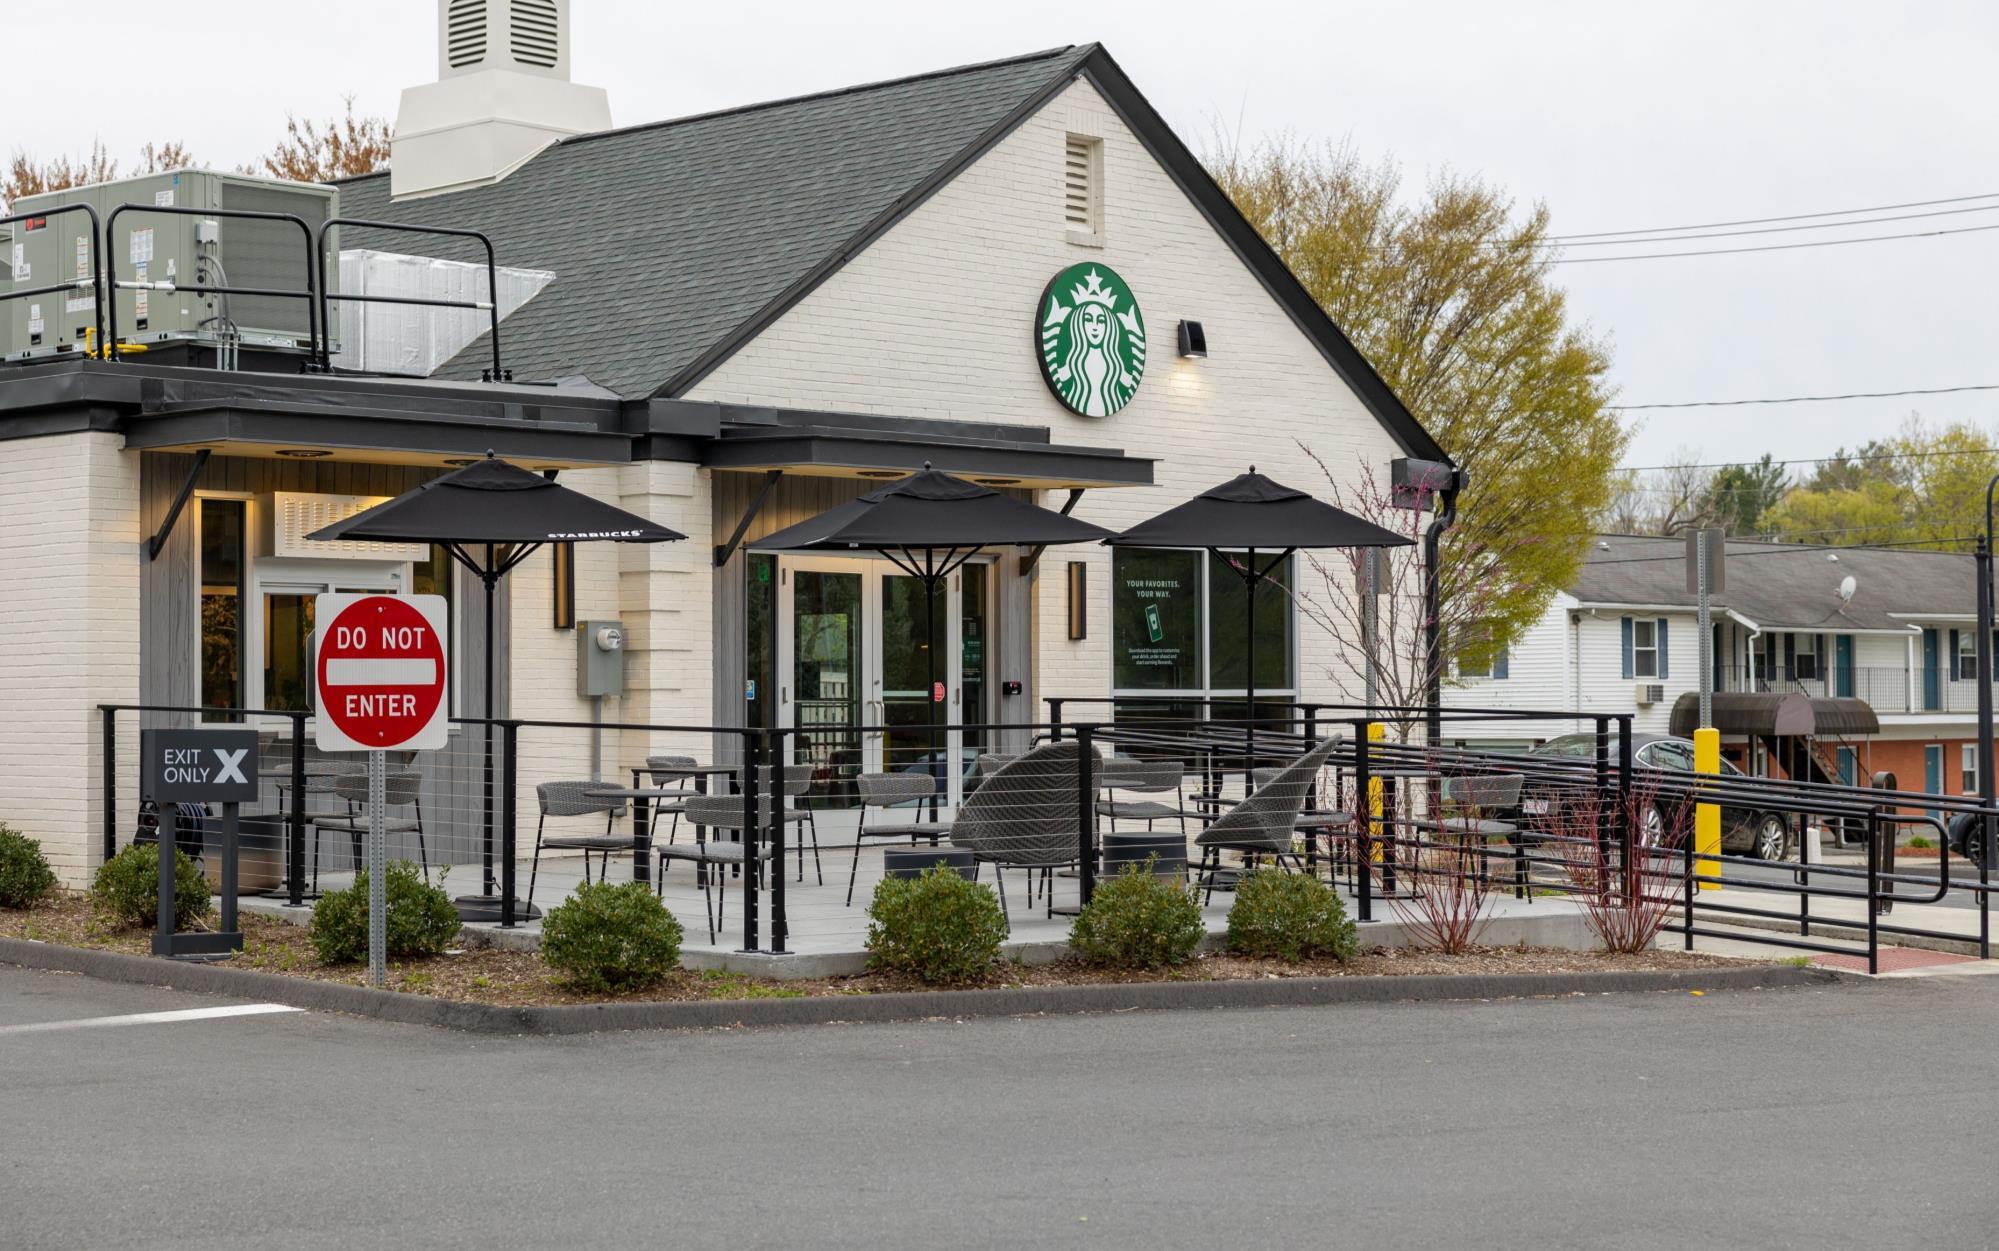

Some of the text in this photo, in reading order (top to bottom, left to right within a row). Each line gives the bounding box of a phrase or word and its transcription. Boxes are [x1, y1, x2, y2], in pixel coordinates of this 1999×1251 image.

[1127, 580, 1144, 588] YOUR
[1137, 590, 1171, 598] YOUR WAY.
[337, 626, 425, 650] DO NOT
[346, 694, 416, 717] ENTER
[164, 749, 201, 764] EXIT
[164, 767, 210, 783] ONLY
